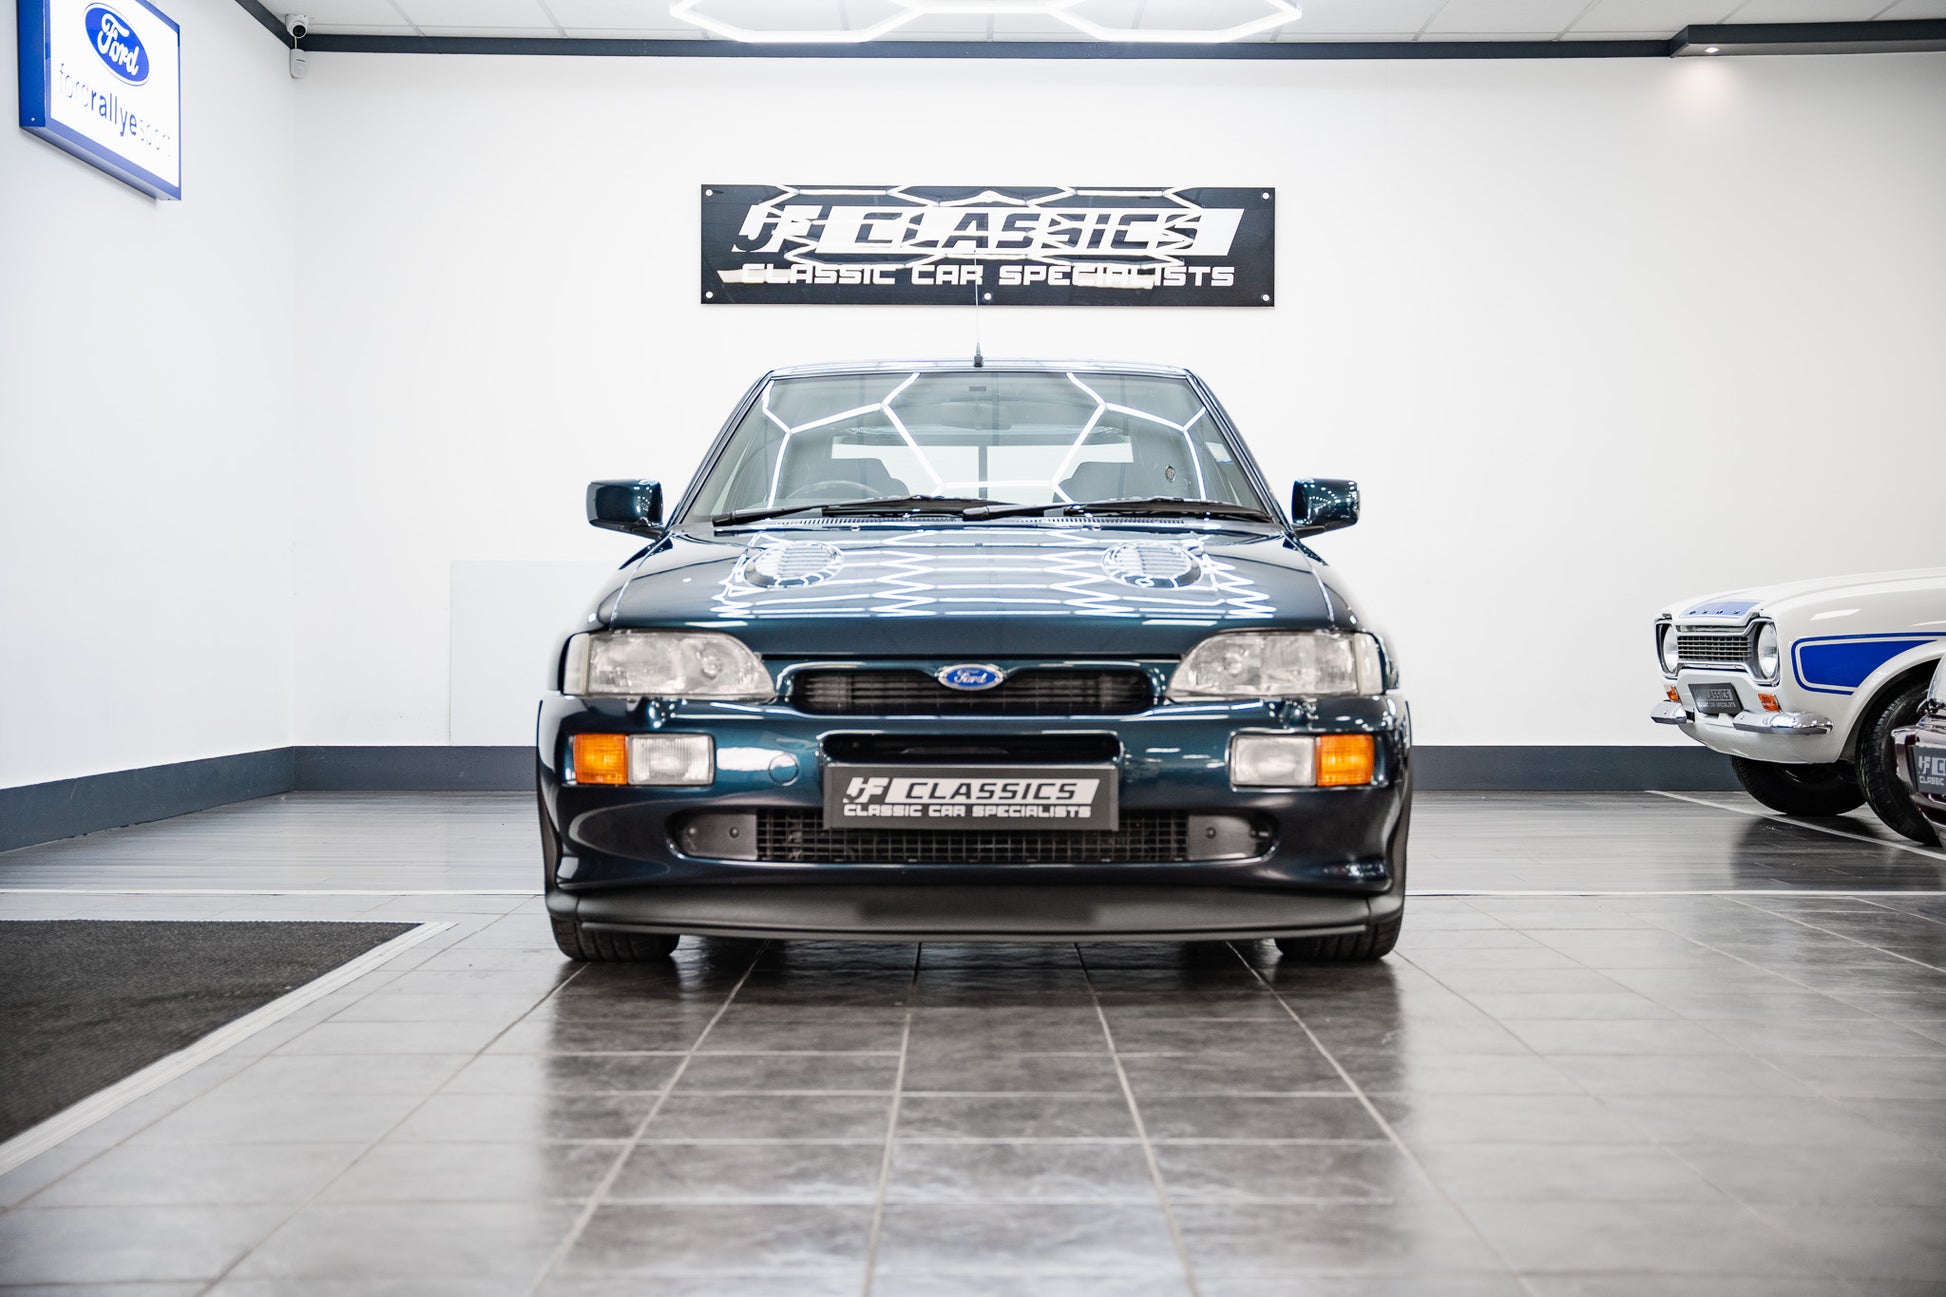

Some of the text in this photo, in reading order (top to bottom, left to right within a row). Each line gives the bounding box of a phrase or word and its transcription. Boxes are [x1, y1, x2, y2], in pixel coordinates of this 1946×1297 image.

[97, 13, 139, 76] Ford
[855, 212, 1201, 249] CLASSICS
[742, 263, 1235, 288] CLASSIC CAR SPECIALISTS
[953, 669, 988, 684] Ford
[905, 782, 1078, 800] CLASSICS
[843, 804, 1092, 818] CLASSIC CAR SPECIALISTS
